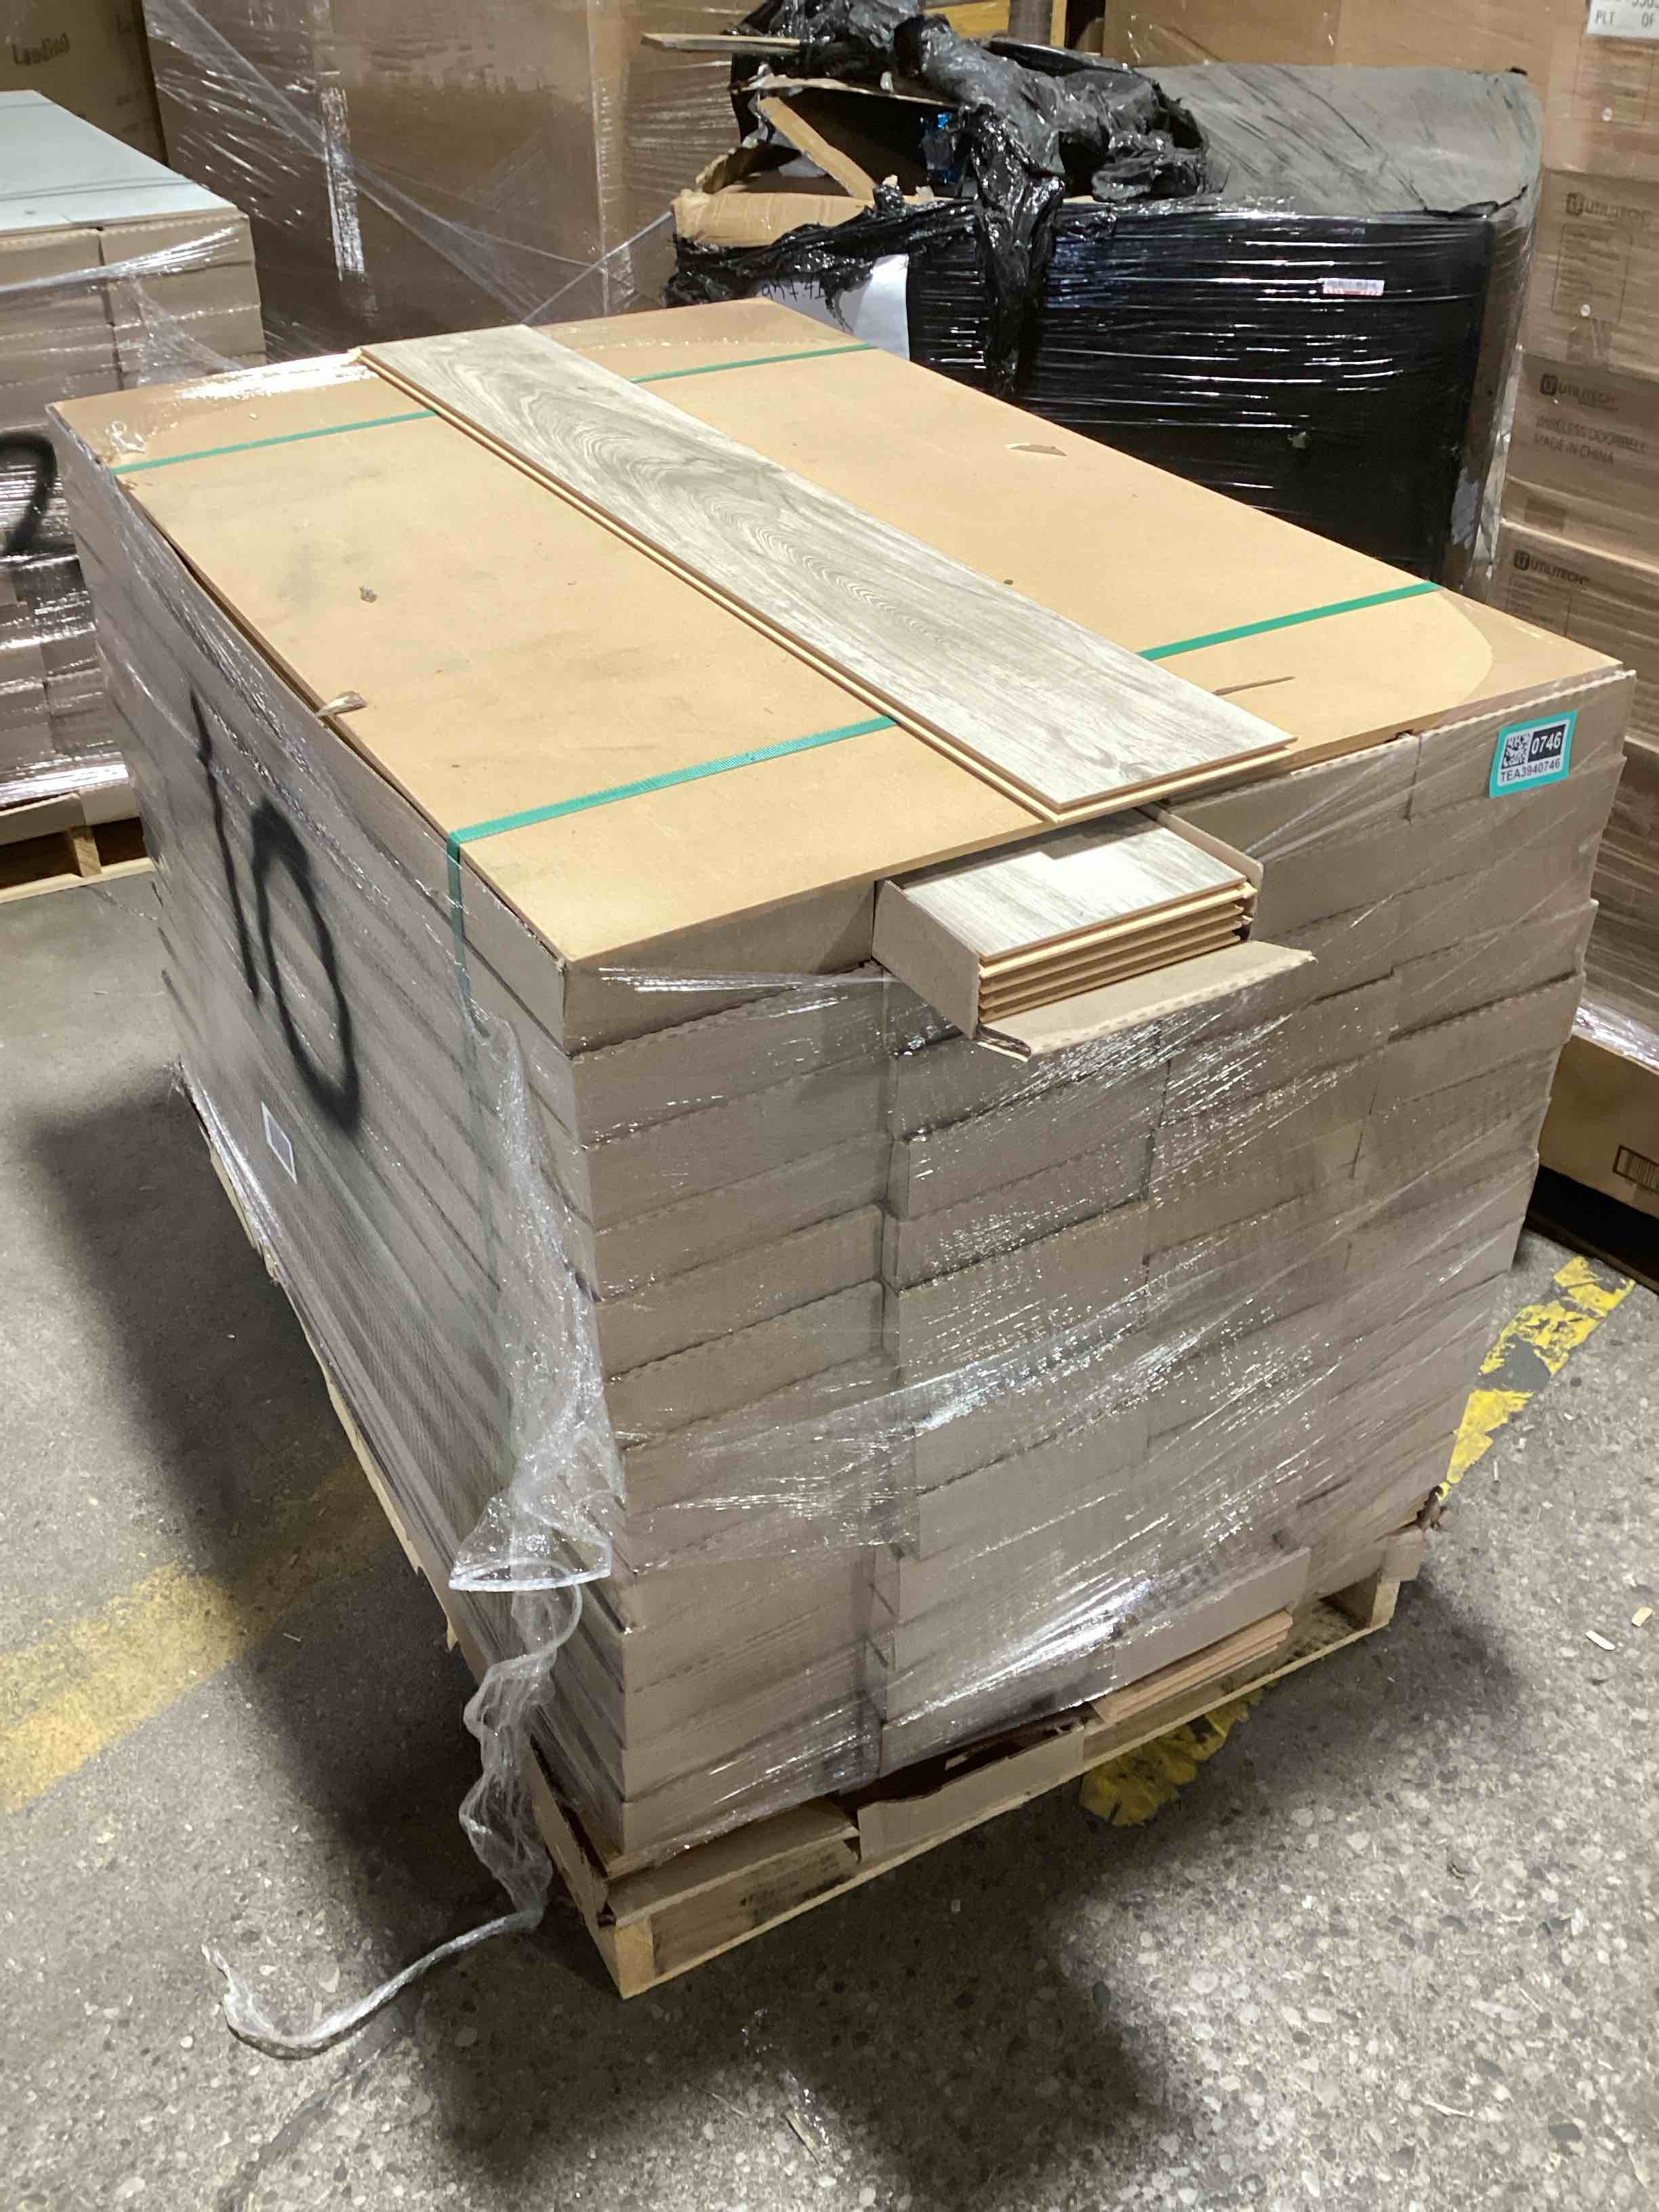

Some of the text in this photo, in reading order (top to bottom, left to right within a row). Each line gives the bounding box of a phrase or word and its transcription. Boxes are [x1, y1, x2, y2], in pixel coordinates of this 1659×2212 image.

[1595, 10, 1656, 28] PLT OF
[1534, 433, 1614, 466] MADE IN CHINA
[1531, 731, 1562, 755] 0746
[1500, 758, 1561, 783] TEA3940746
